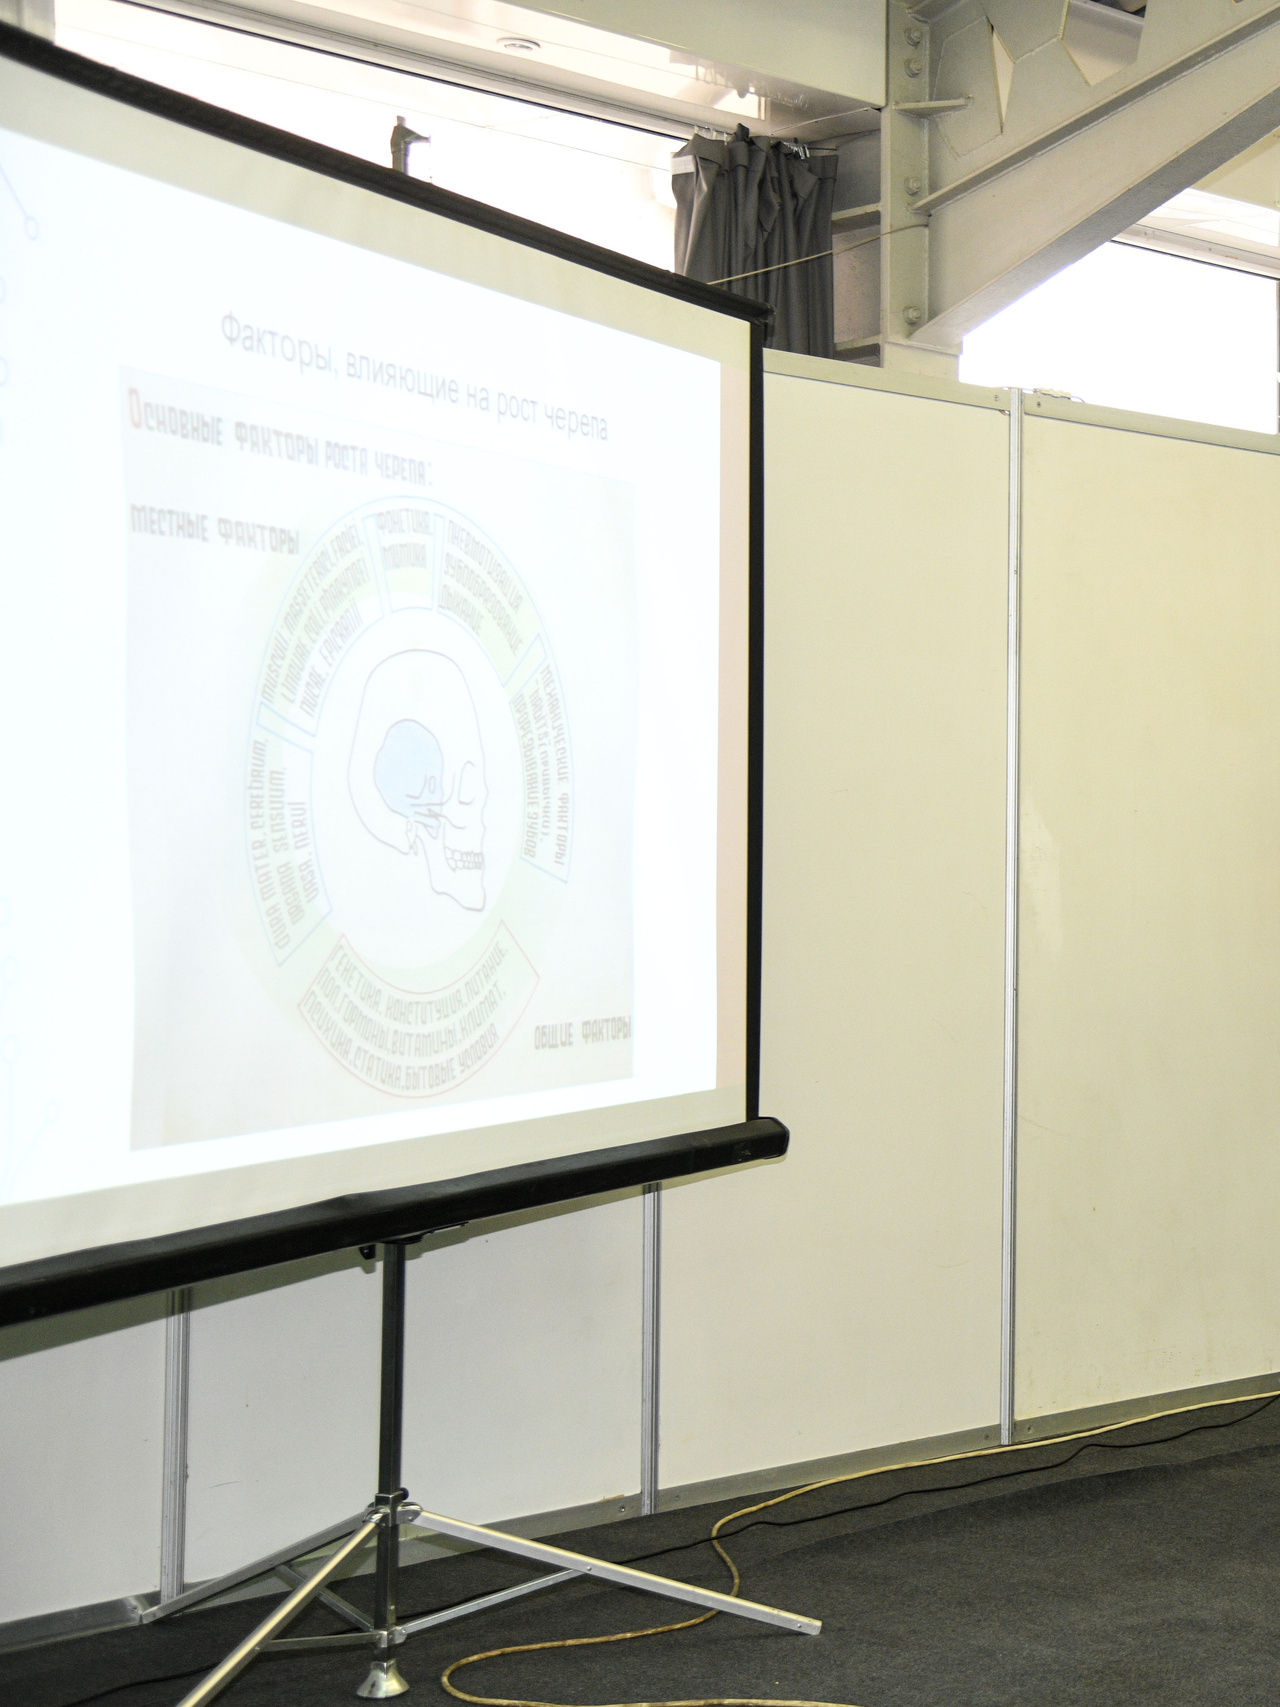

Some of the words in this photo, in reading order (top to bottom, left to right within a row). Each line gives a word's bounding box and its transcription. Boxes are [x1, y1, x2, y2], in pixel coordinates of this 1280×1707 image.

[221, 311, 339, 380] Факторы,
[346, 352, 459, 405] влияющие
[466, 384, 490, 412] на
[497, 391, 539, 424] рост
[544, 406, 609, 441] черепа
[234, 421, 319, 467] ФАКТОРЫ
[325, 440, 368, 476] РОСТА
[130, 503, 210, 543] МЕСТНЫЕ
[217, 517, 300, 555] ФАКТОРЫ
[534, 1021, 574, 1050] ОБЩИЕ
[581, 1015, 632, 1045] ФАКТОРЫ
